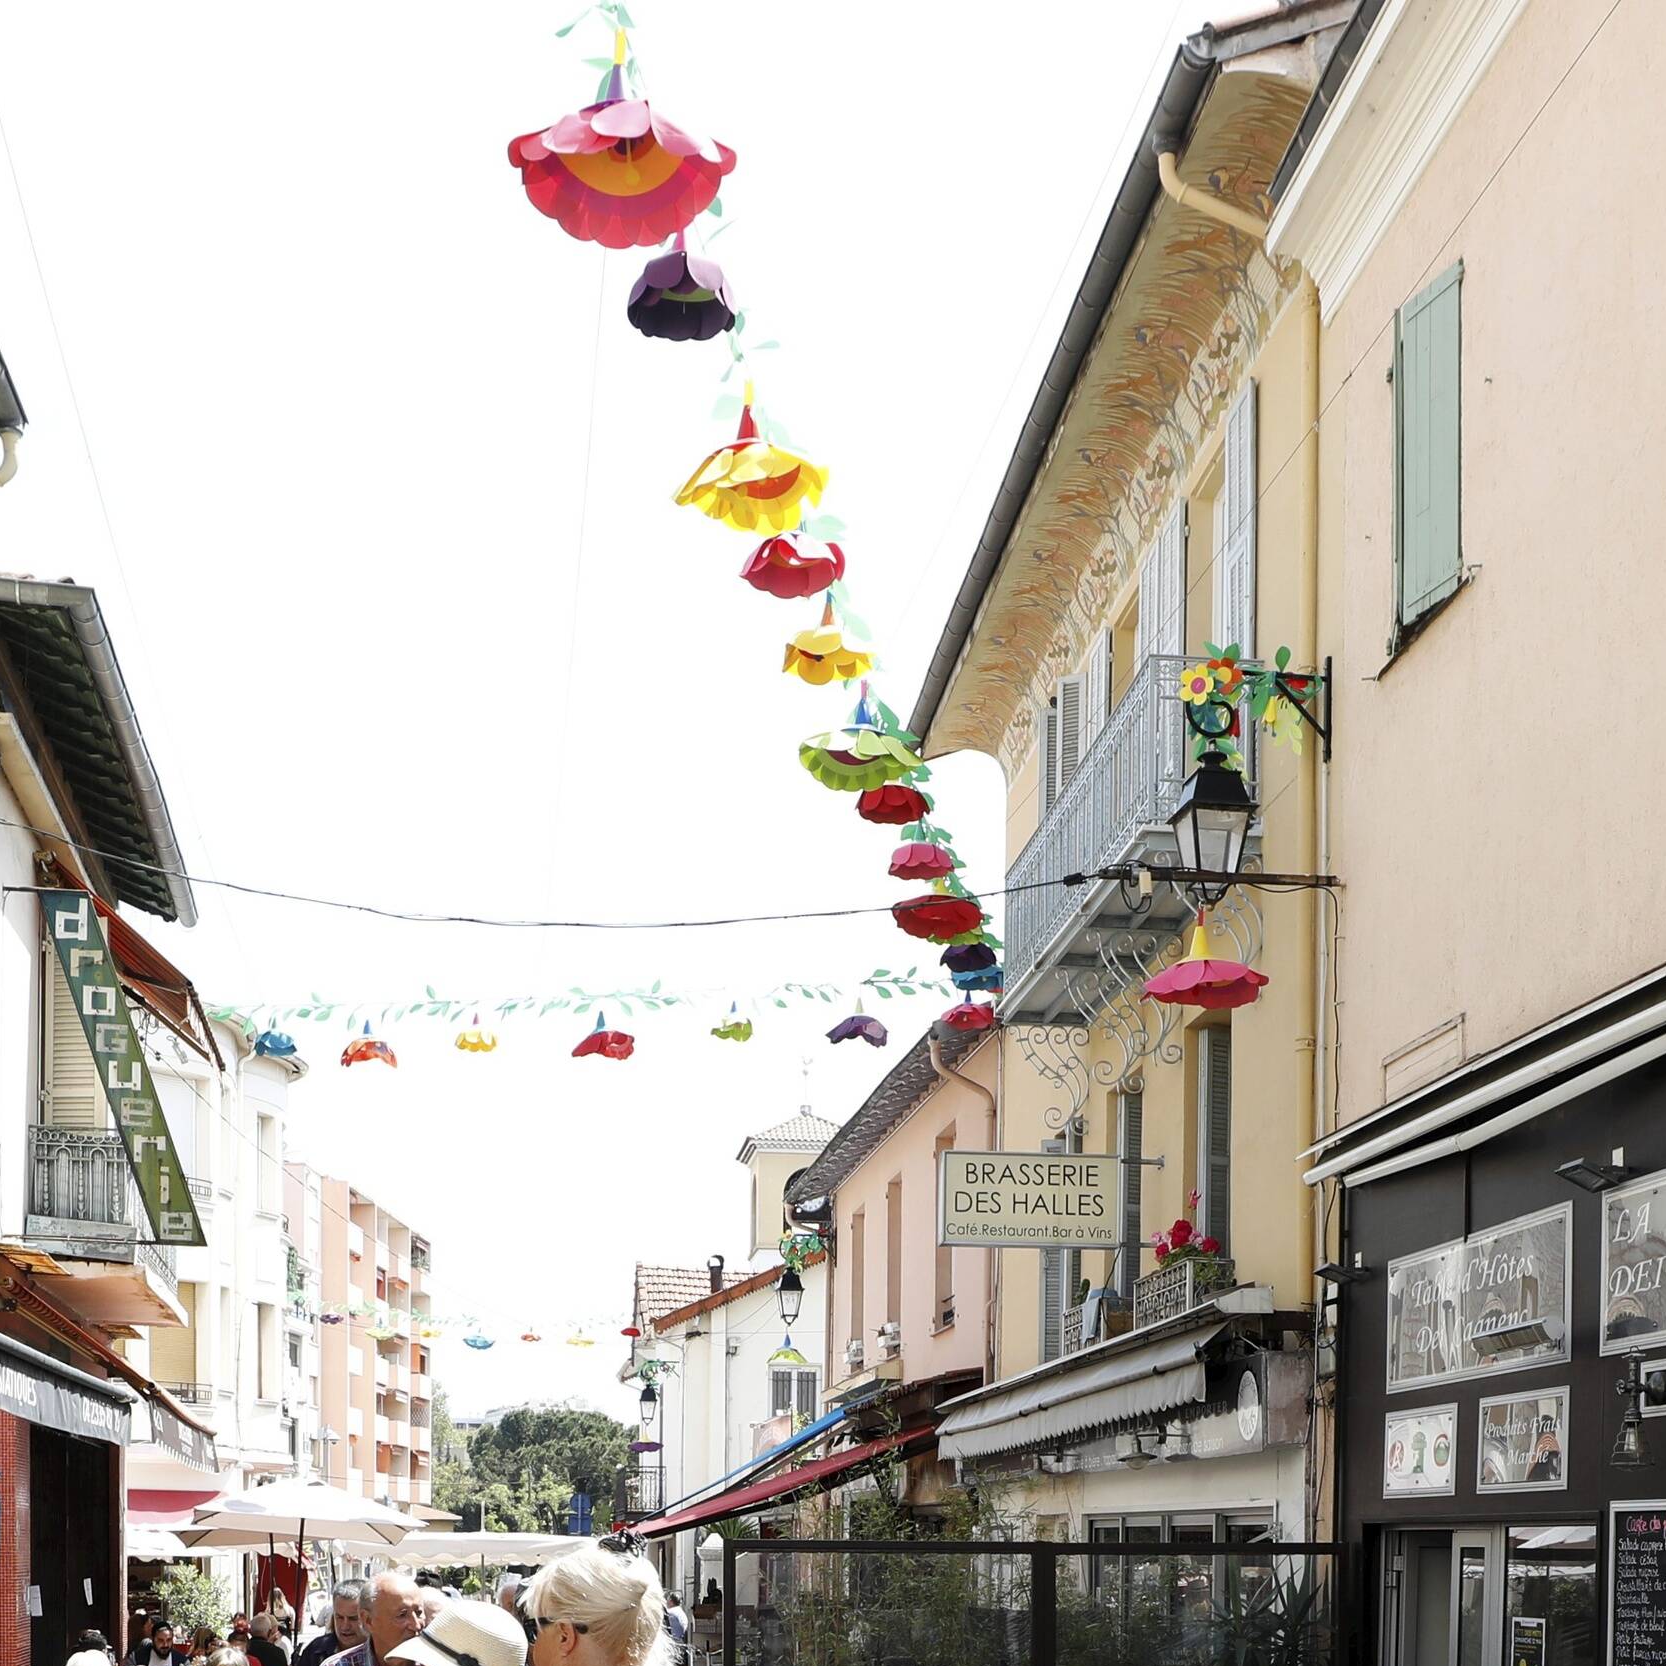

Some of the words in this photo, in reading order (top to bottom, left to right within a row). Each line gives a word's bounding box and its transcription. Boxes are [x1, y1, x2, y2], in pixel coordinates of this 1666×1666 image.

[965, 1162, 1099, 1187] BRASSERIE
[954, 1191, 1002, 1214] DES
[1012, 1193, 1104, 1217] HALLES
[1075, 1225, 1084, 1239] à
[1087, 1226, 1112, 1240] Vins
[1612, 1202, 1651, 1244] LA
[1507, 1446, 1550, 1466] Marché
